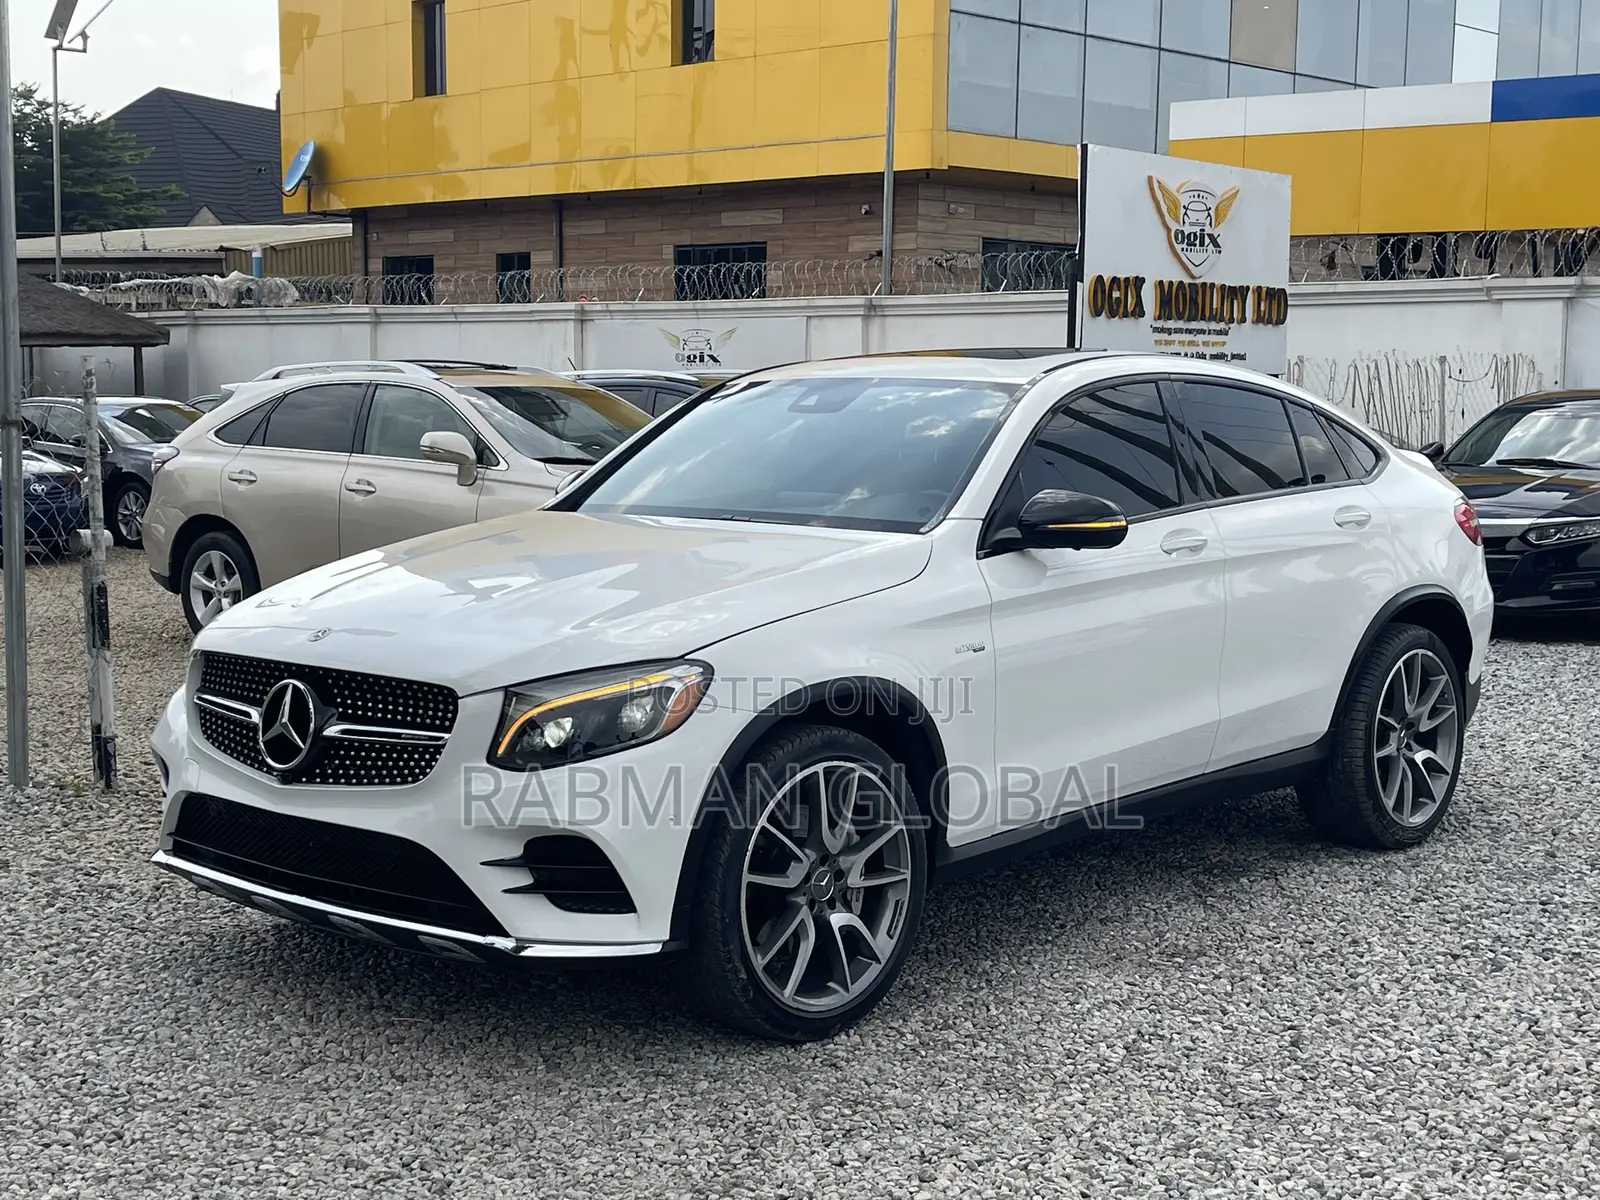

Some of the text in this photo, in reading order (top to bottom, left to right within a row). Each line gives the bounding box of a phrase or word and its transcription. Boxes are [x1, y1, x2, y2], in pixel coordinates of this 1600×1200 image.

[1088, 274, 1289, 326] OGIX MOBILITY LTD
